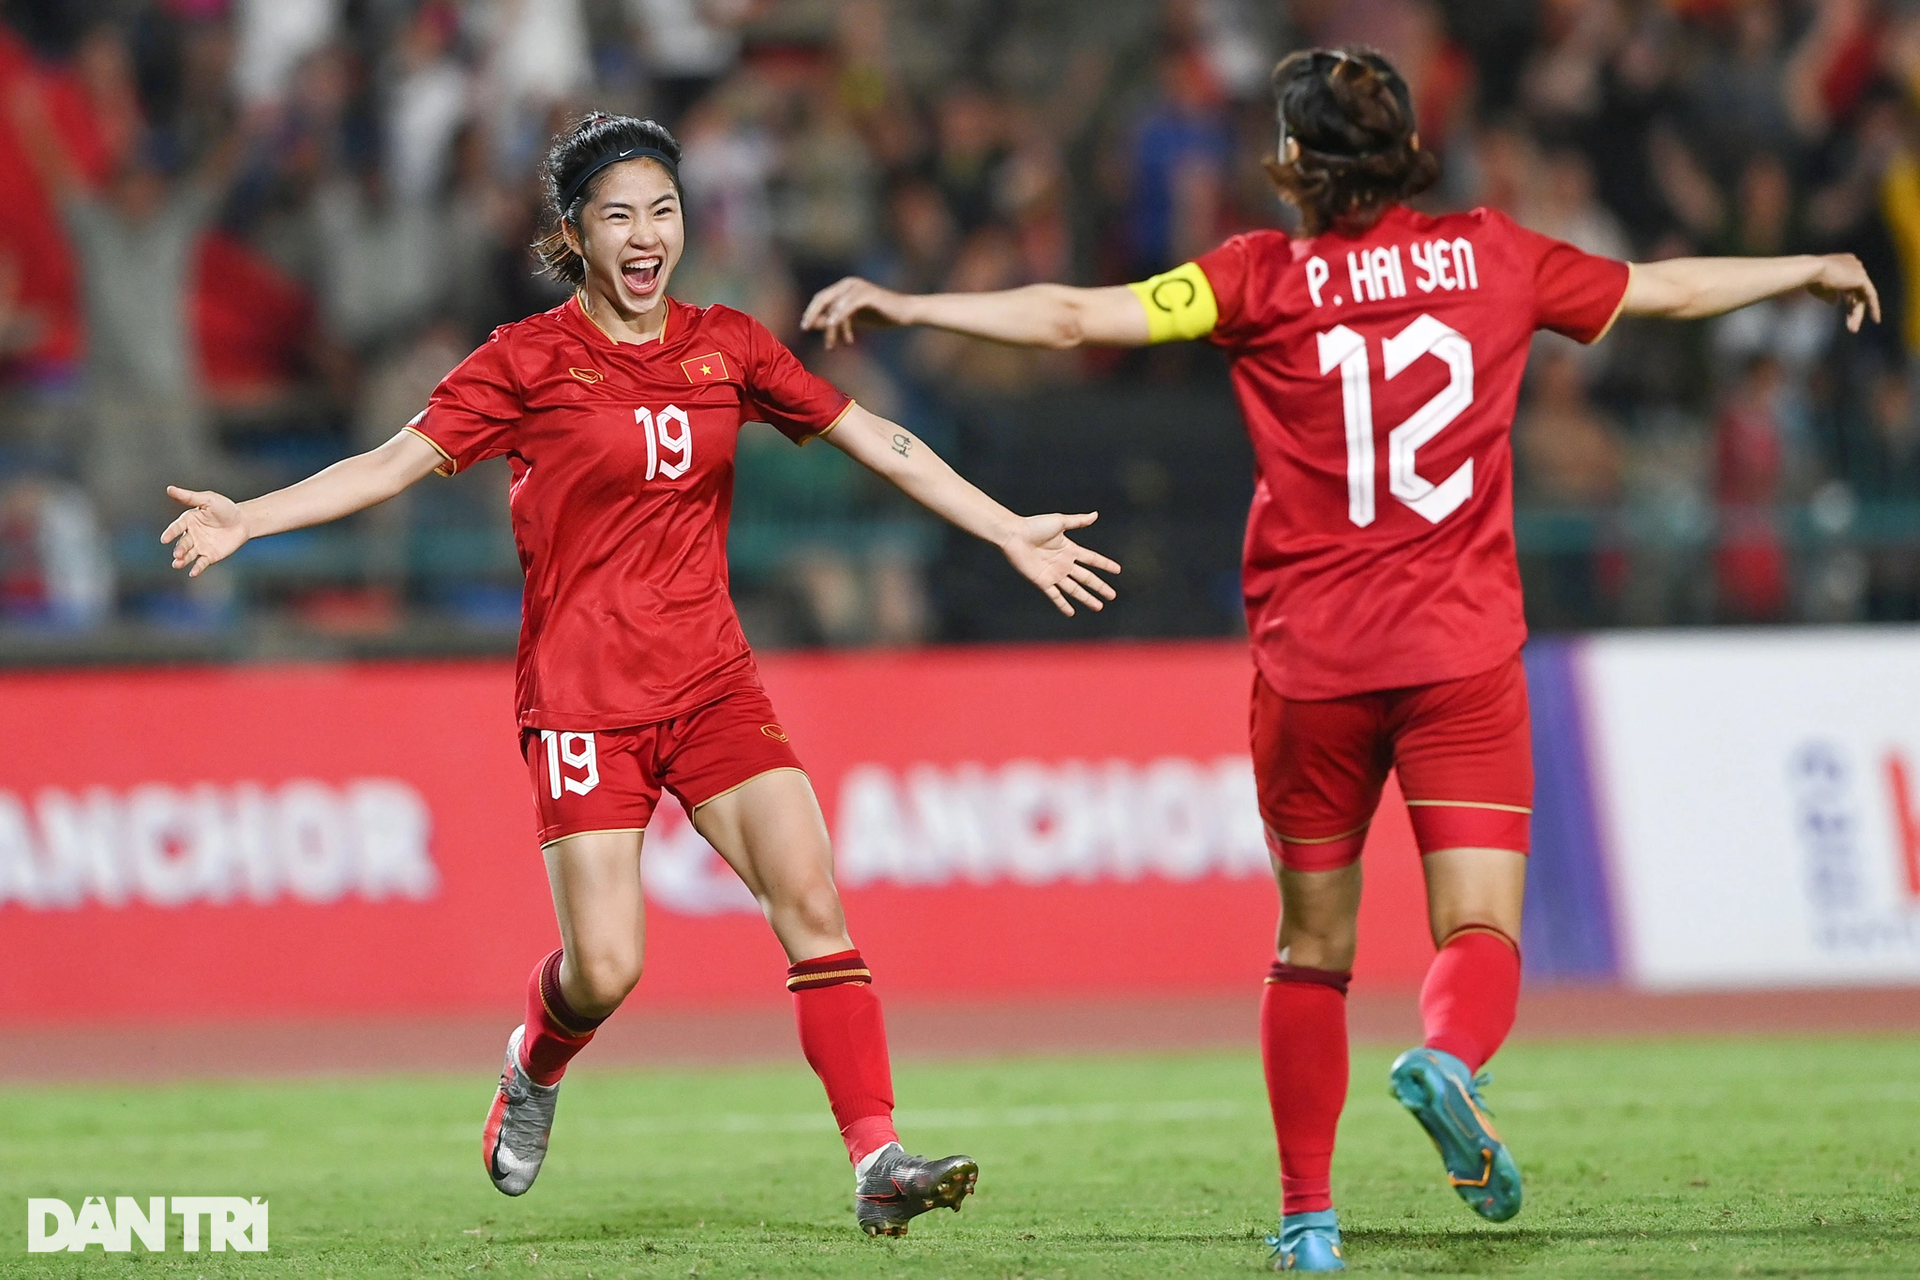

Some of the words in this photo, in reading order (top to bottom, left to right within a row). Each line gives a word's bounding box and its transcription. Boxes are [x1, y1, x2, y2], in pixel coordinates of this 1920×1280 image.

[1152, 277, 1196, 312] C
[1305, 255, 1343, 308] P.
[1347, 243, 1408, 303] HAI
[1410, 236, 1479, 293] YEN
[634, 404, 692, 481] 19
[1316, 313, 1474, 528] 12
[540, 730, 600, 800] 19
